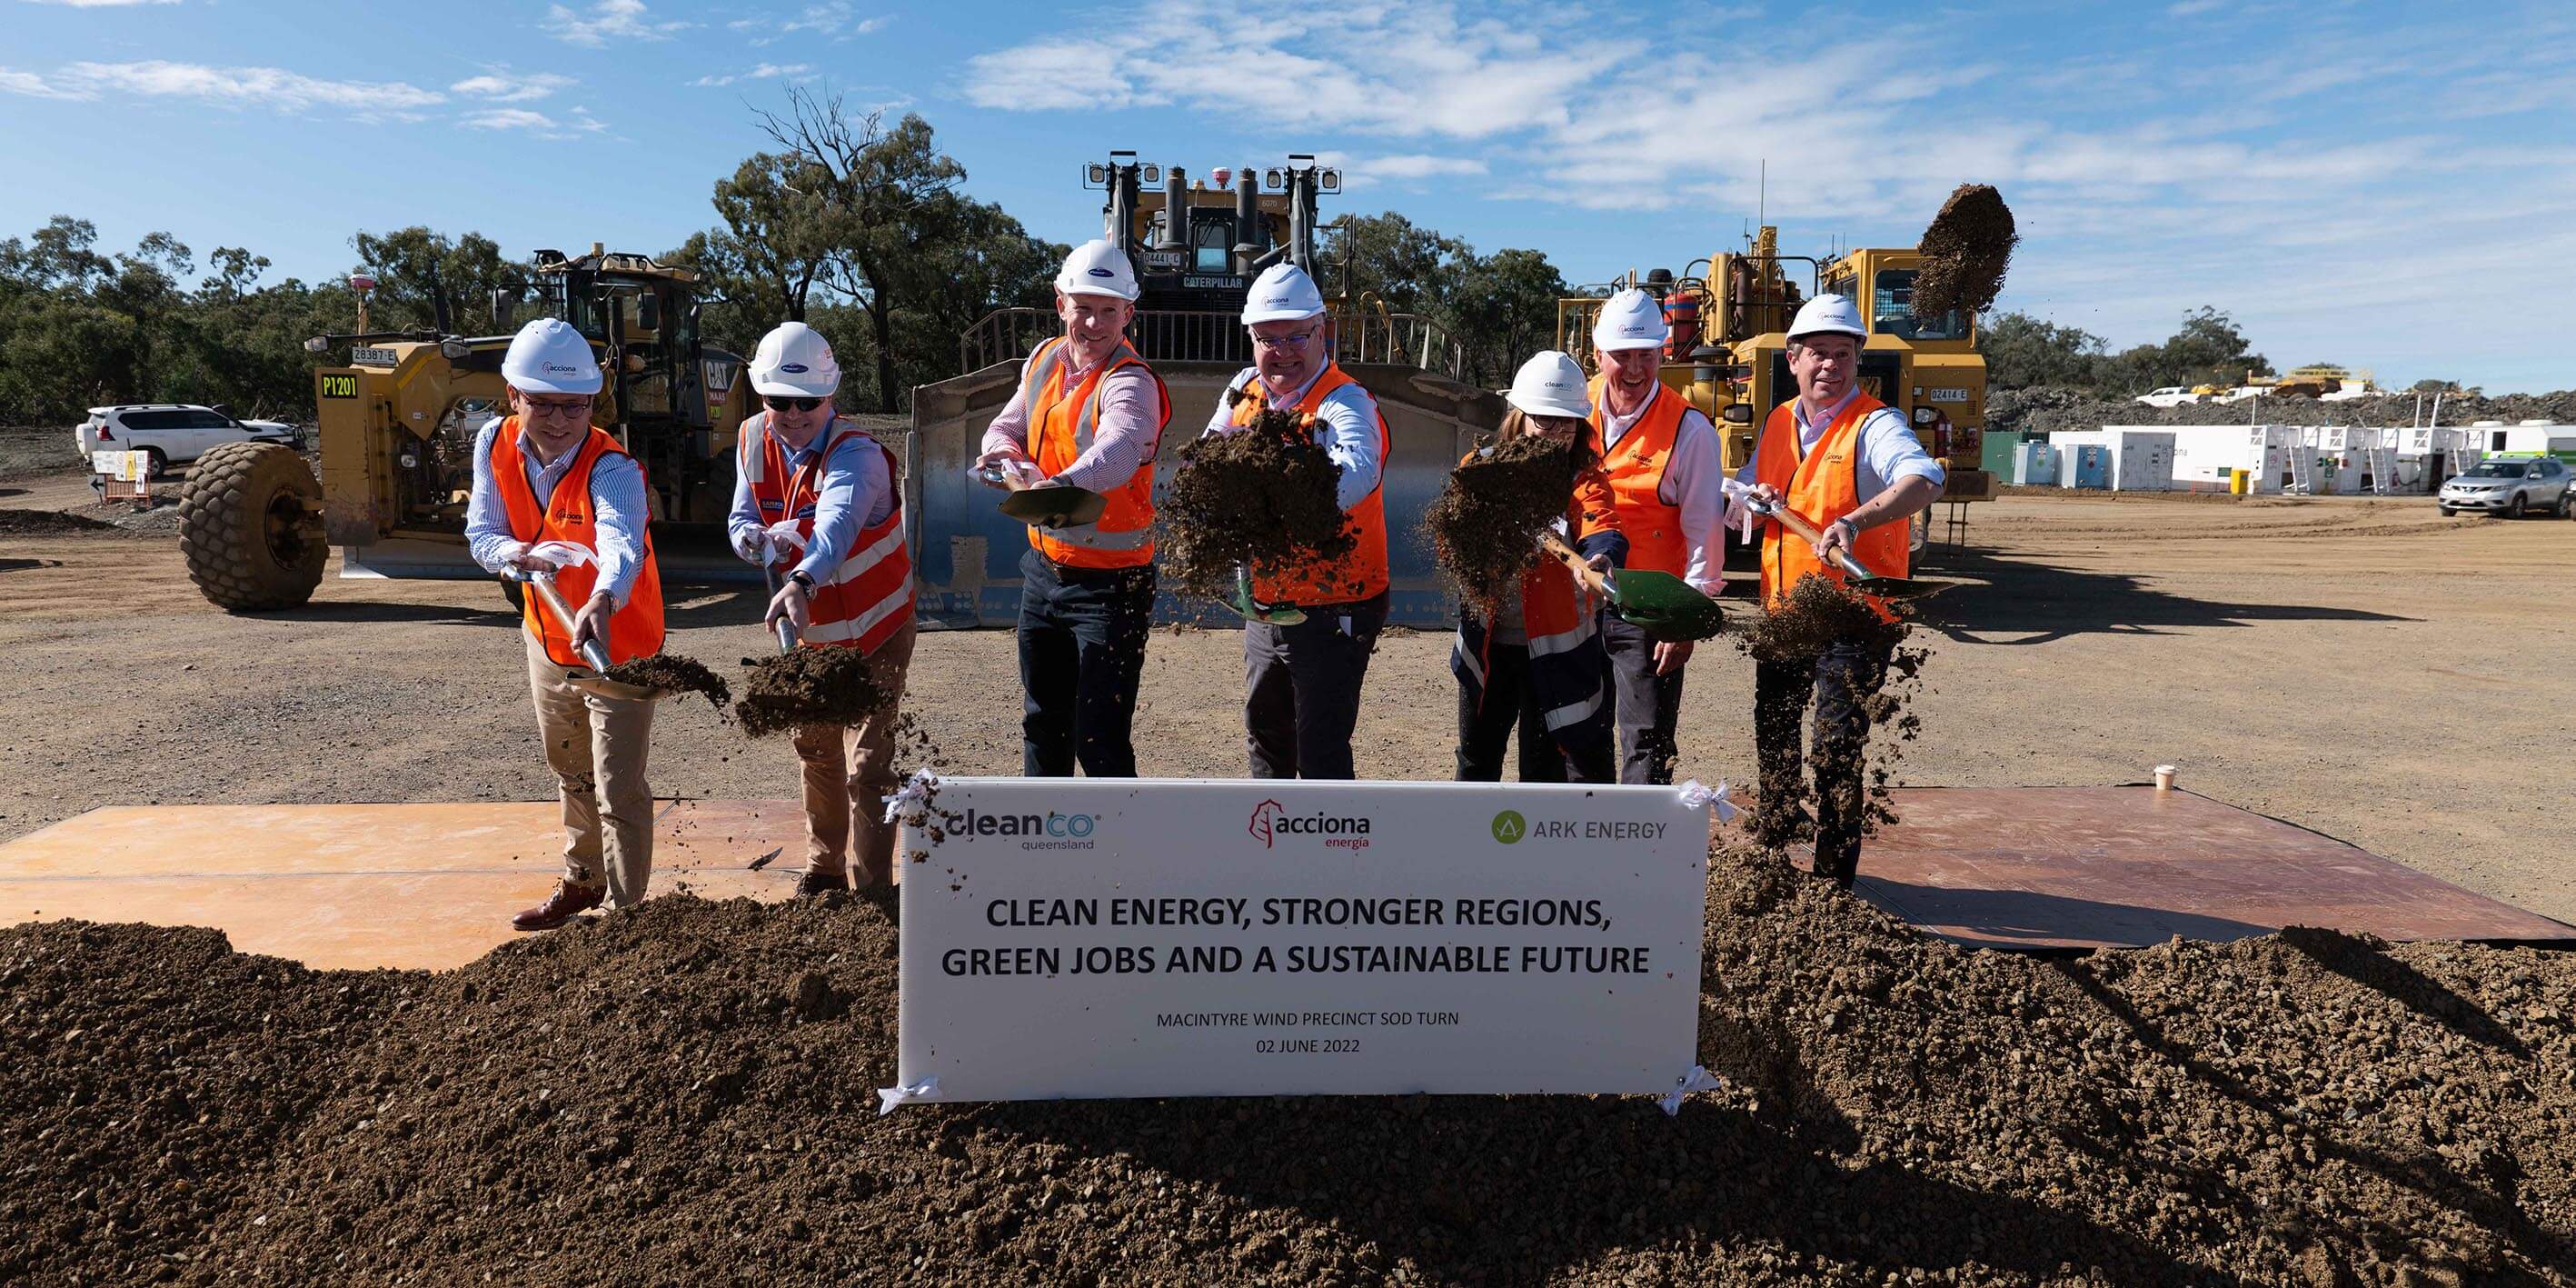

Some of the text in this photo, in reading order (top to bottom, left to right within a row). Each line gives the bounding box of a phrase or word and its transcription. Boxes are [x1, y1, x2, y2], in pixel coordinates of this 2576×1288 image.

[1184, 276, 1242, 288] CATERPILLAR
[706, 361, 728, 389] CAT
[323, 377, 356, 396] P1201
[709, 392, 726, 401] MAAS
[945, 808, 1094, 838] cleanco
[1276, 812, 1370, 834] acciona
[1534, 821, 1667, 839] ARK ENERGY
[1021, 839, 1094, 851] queensland
[1325, 836, 1369, 851] energía
[987, 897, 1612, 931] CLEAN ENERGY, STRONGER REGIONS,
[941, 945, 1650, 976] GREEN JOBS AND A SUSTAINABLE FUTURE
[1157, 1012, 1459, 1027] MACINTYRE WIND PRECINCT SOD TURN
[1256, 1039, 1360, 1053] 02 JUNE 2022
